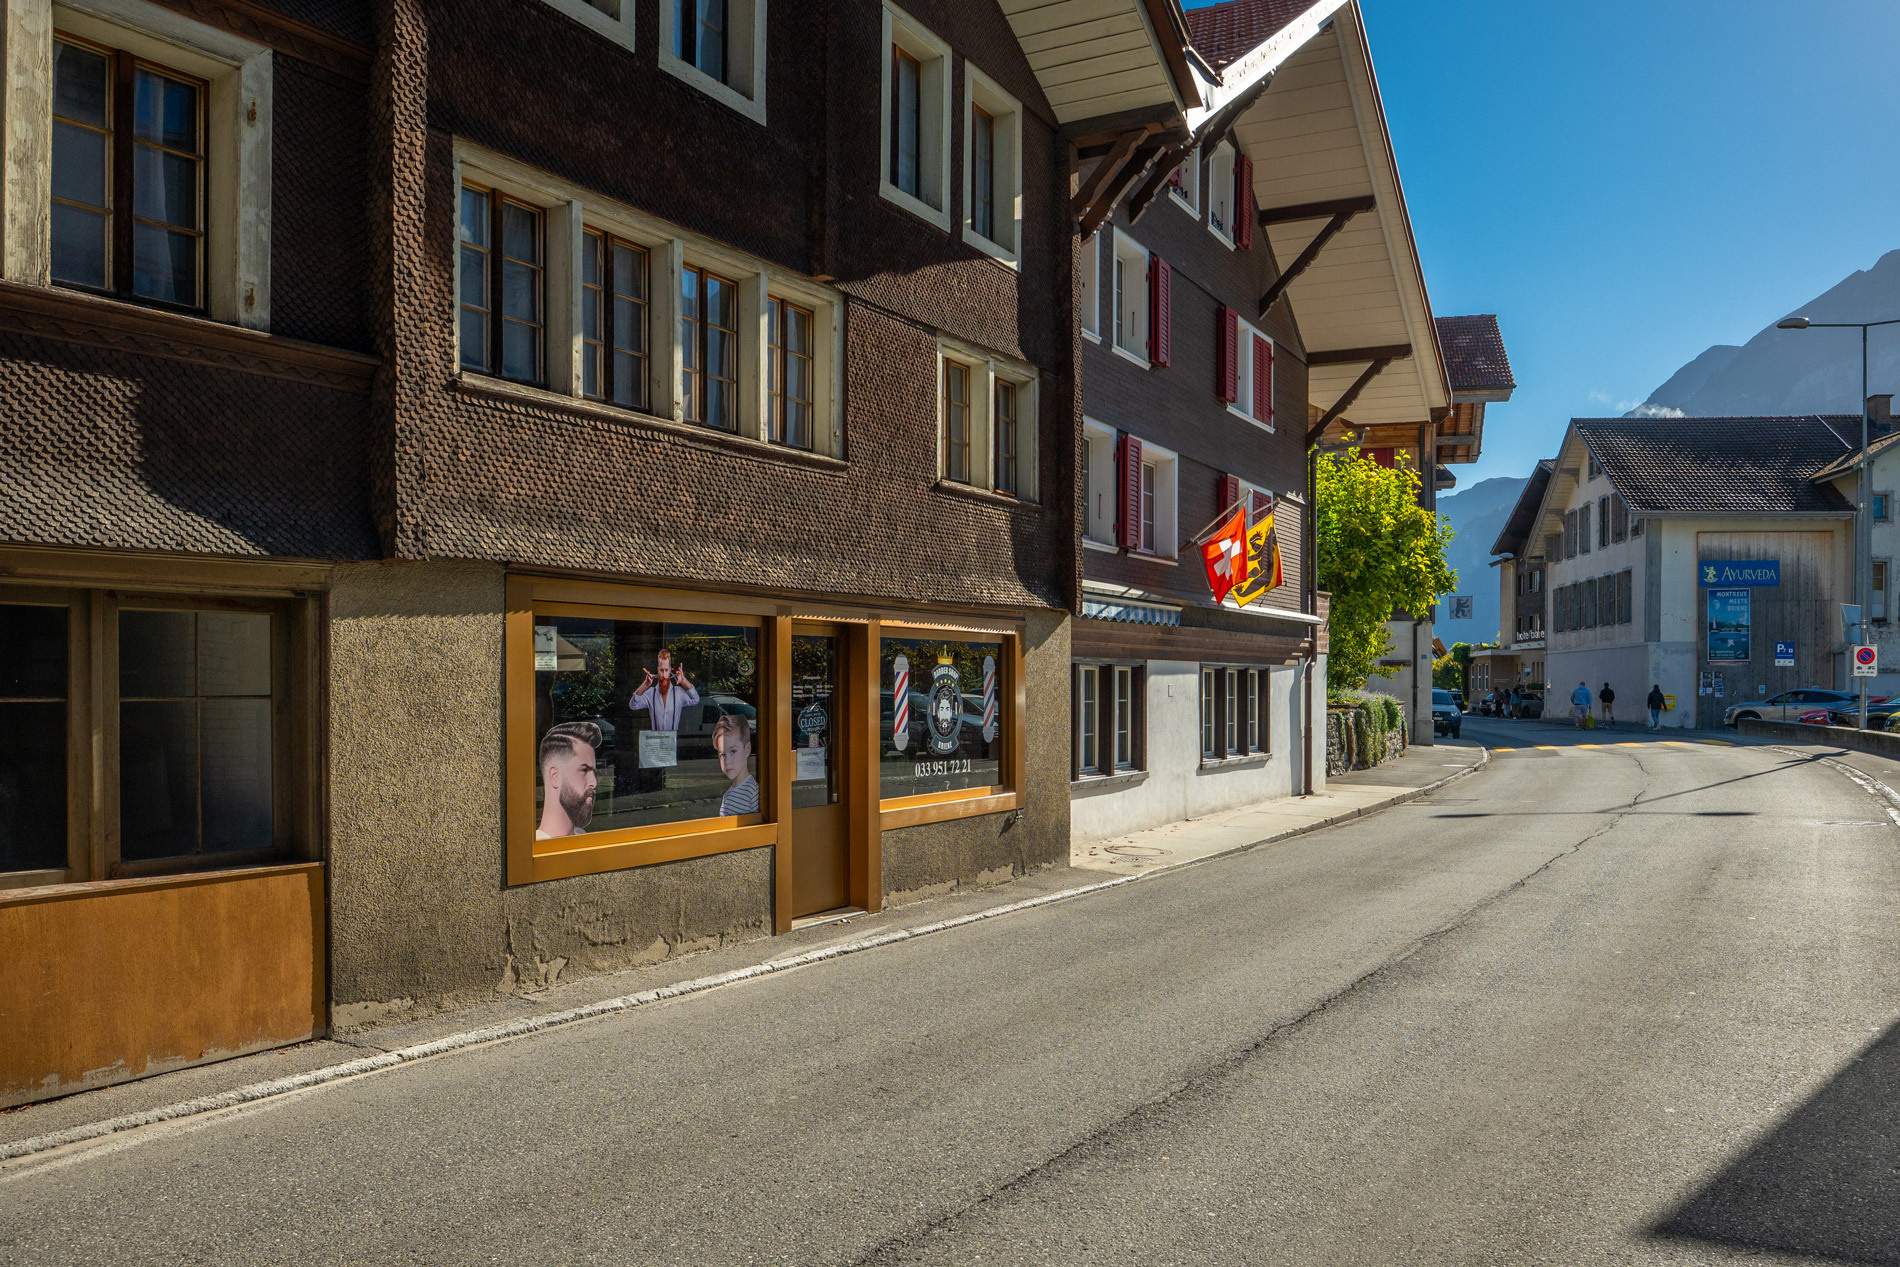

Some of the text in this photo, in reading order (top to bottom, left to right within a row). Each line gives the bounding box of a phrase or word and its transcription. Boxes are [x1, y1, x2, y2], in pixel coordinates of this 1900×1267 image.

[1721, 566, 1777, 581] AYURVEDA
[1777, 644, 1784, 653] P
[800, 716, 826, 728] CLOSED
[915, 758, 971, 778] 033 951 72 21
